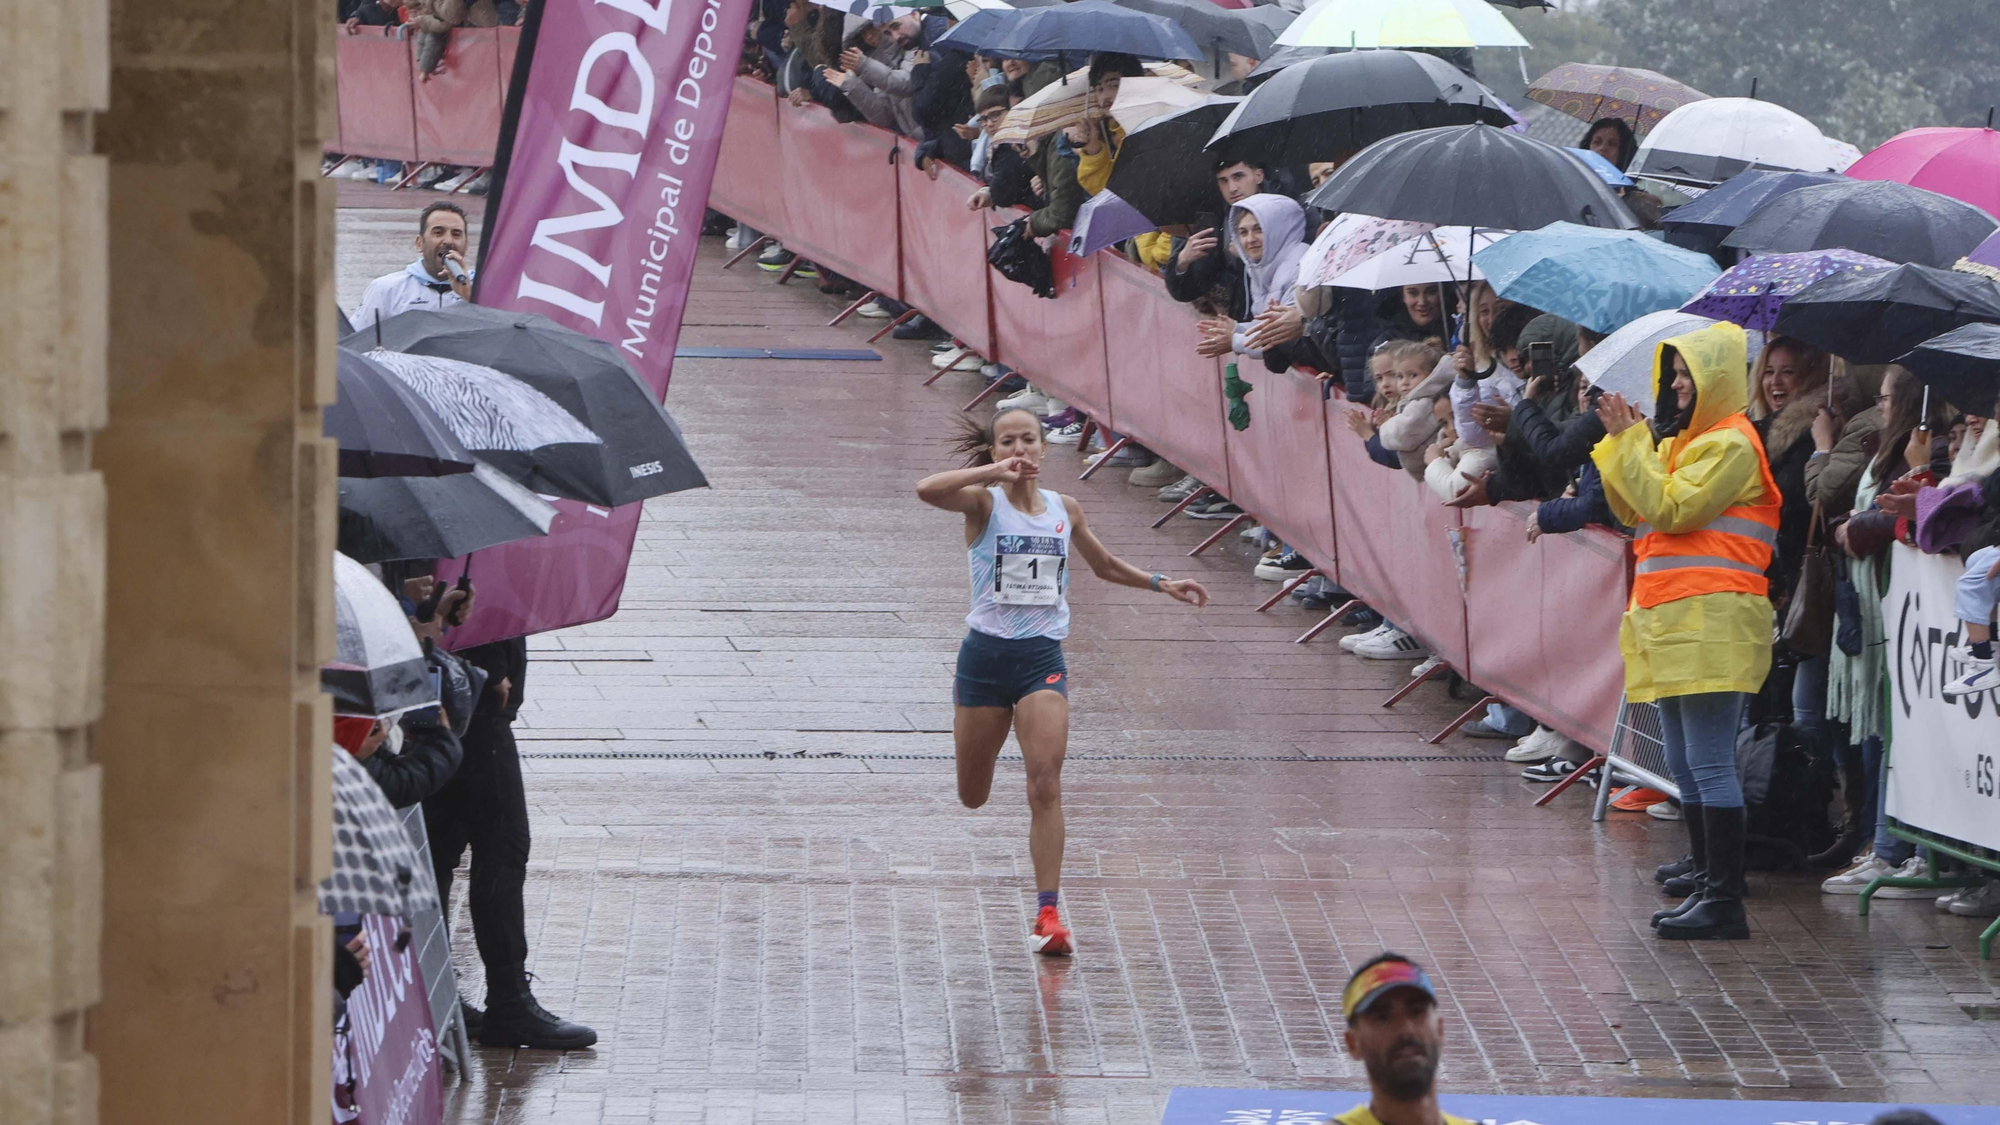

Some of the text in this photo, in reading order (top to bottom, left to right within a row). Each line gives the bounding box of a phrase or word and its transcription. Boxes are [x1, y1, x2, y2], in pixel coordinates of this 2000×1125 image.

[620, 173, 683, 359] Municipal
[664, 118, 695, 166] de
[629, 461, 664, 478] INESIS
[1028, 558, 1037, 579] 1
[1977, 754, 1994, 797] ES
